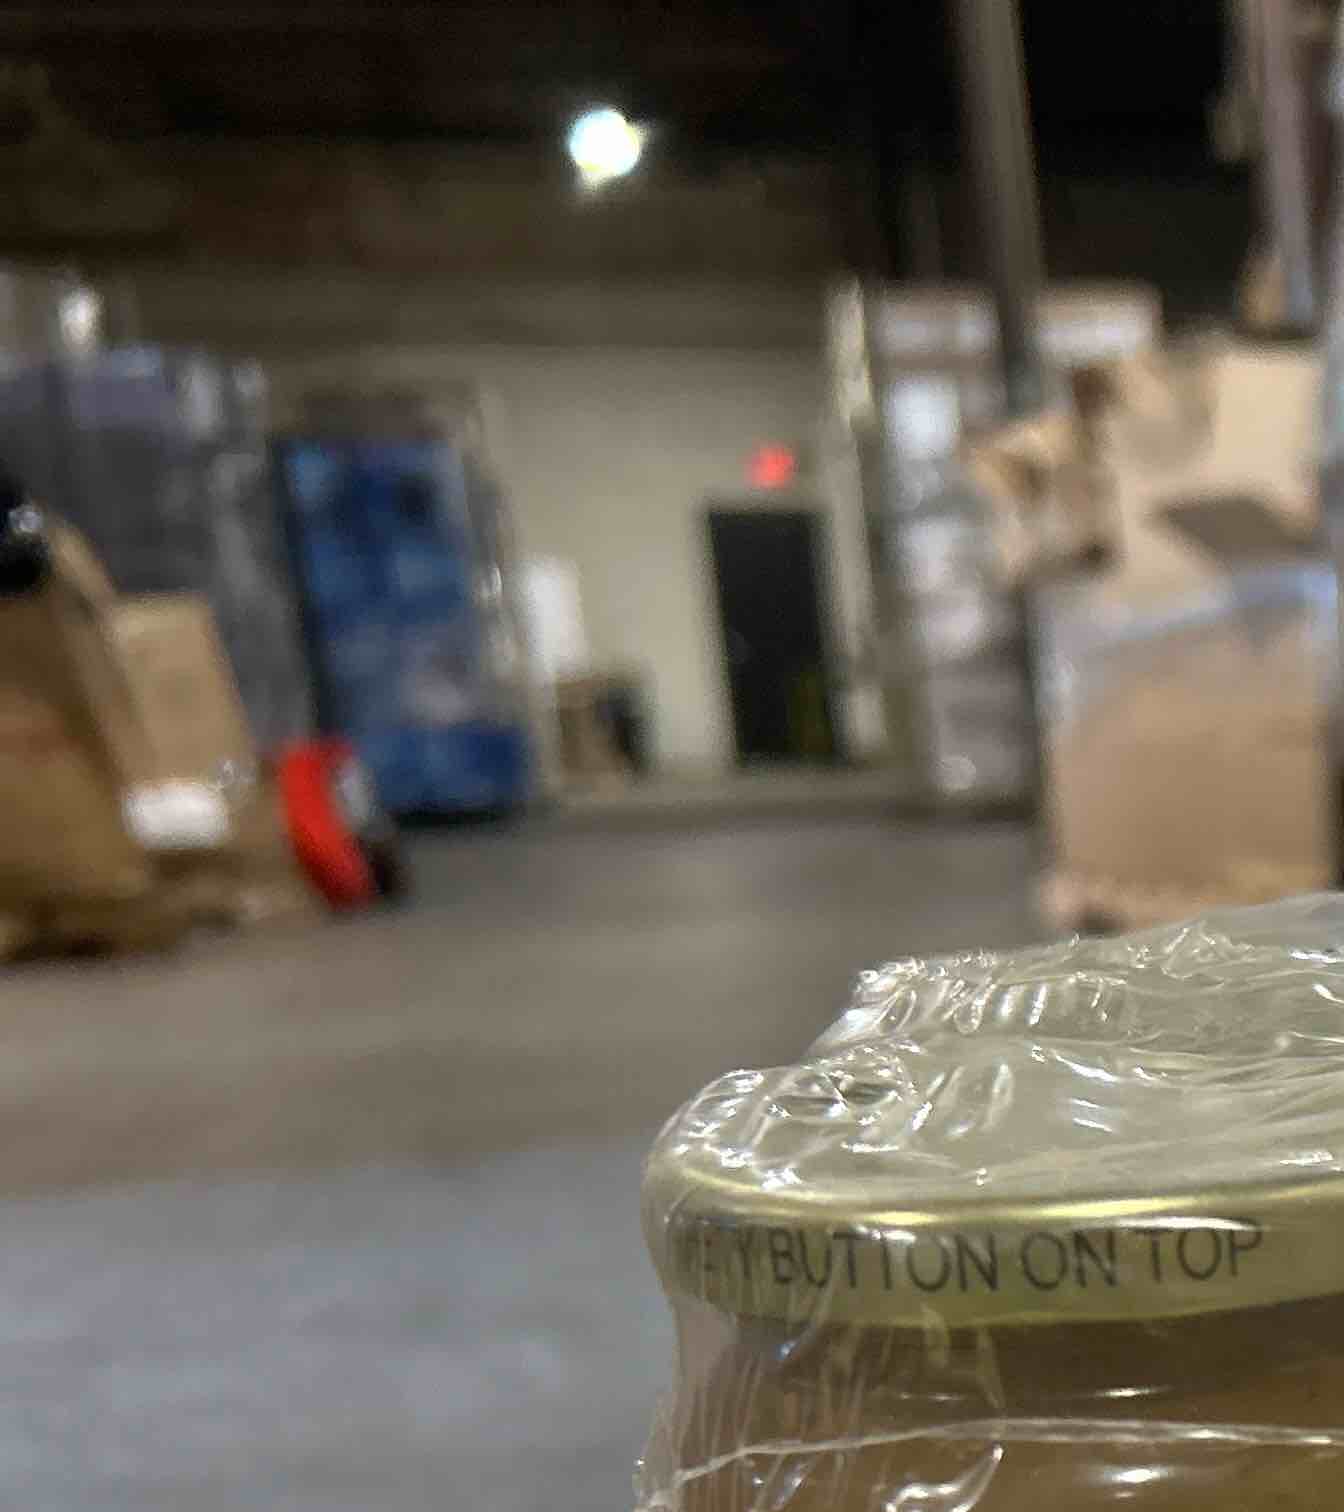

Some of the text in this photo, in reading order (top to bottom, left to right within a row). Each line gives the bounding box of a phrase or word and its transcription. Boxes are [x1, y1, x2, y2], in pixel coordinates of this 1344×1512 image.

[769, 1226, 999, 1293] BUTTON
[1020, 1230, 1117, 1292] ON
[1143, 1220, 1263, 1281] TOP
